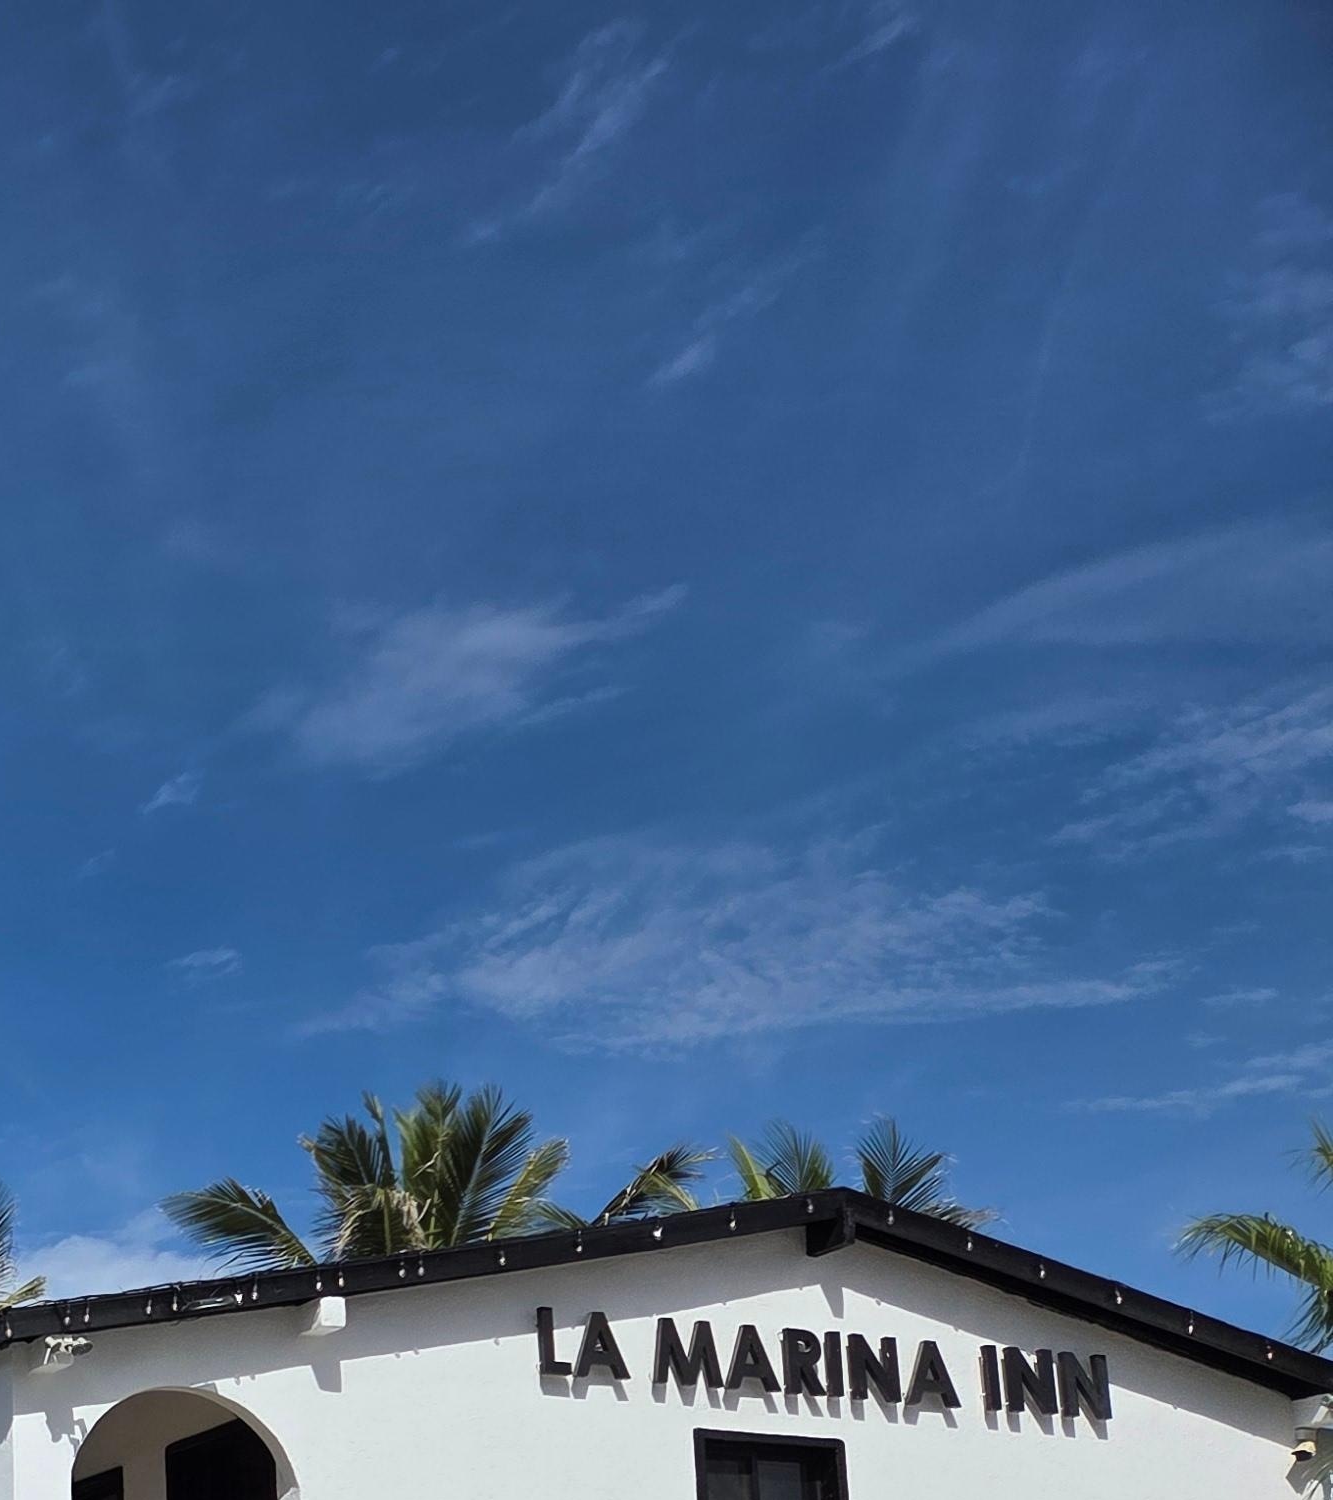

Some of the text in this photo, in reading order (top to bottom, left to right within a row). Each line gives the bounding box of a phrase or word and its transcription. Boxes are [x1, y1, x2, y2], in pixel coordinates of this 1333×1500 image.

[536, 1306, 1113, 1420] LA MARINA INN
